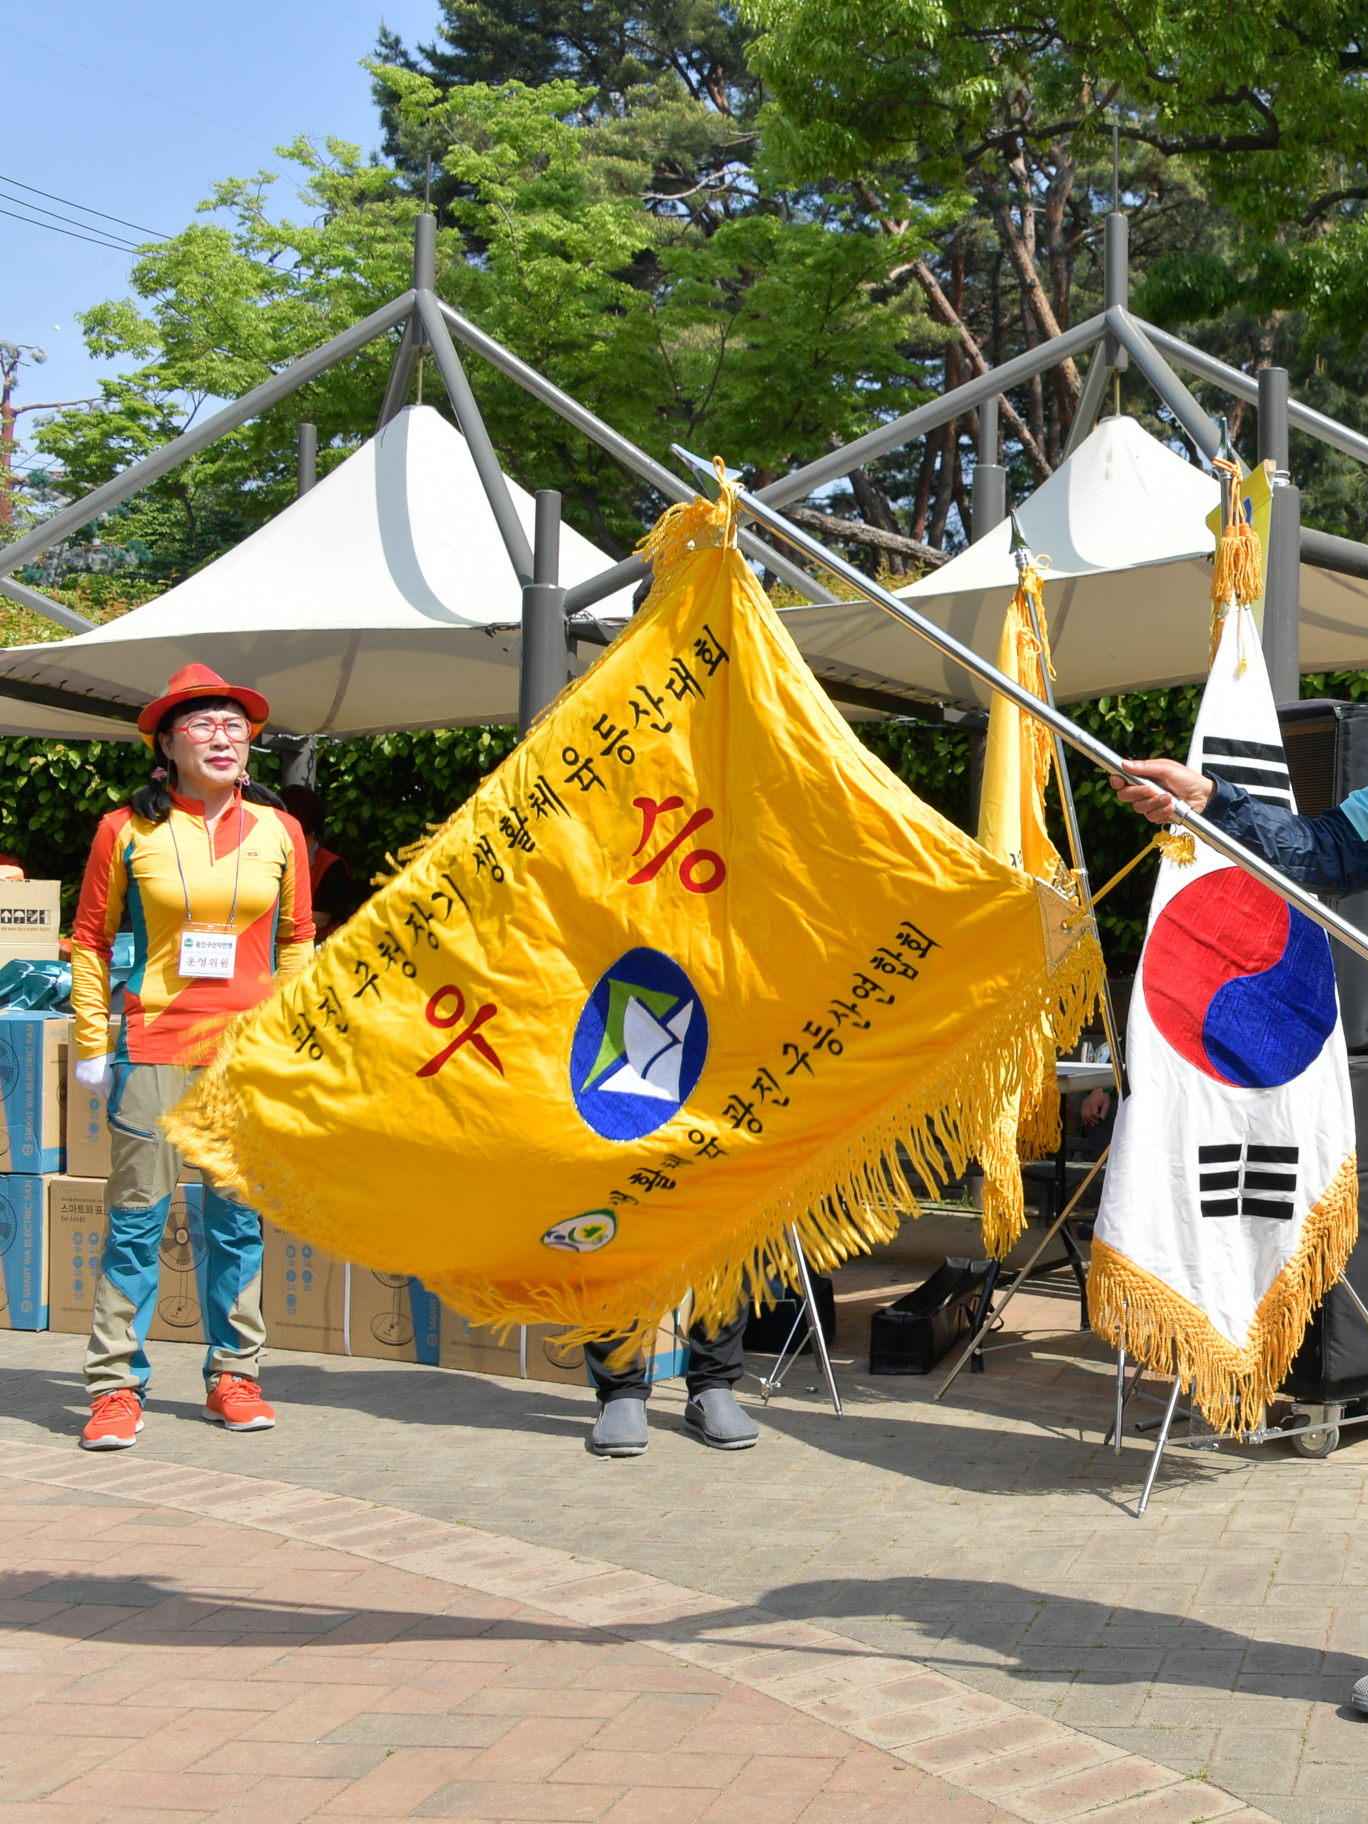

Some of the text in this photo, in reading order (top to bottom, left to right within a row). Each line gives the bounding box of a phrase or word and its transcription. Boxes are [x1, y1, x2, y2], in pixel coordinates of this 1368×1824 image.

[186, 956, 229, 968] 운영위원
[24, 1024, 34, 1141] SMART WA ELECTRIC FAN
[61, 1203, 94, 1215] 스마트와
[23, 1180, 33, 1298] SMART WA ELECTRIC FAN
[429, 1298, 438, 1331] SMART
